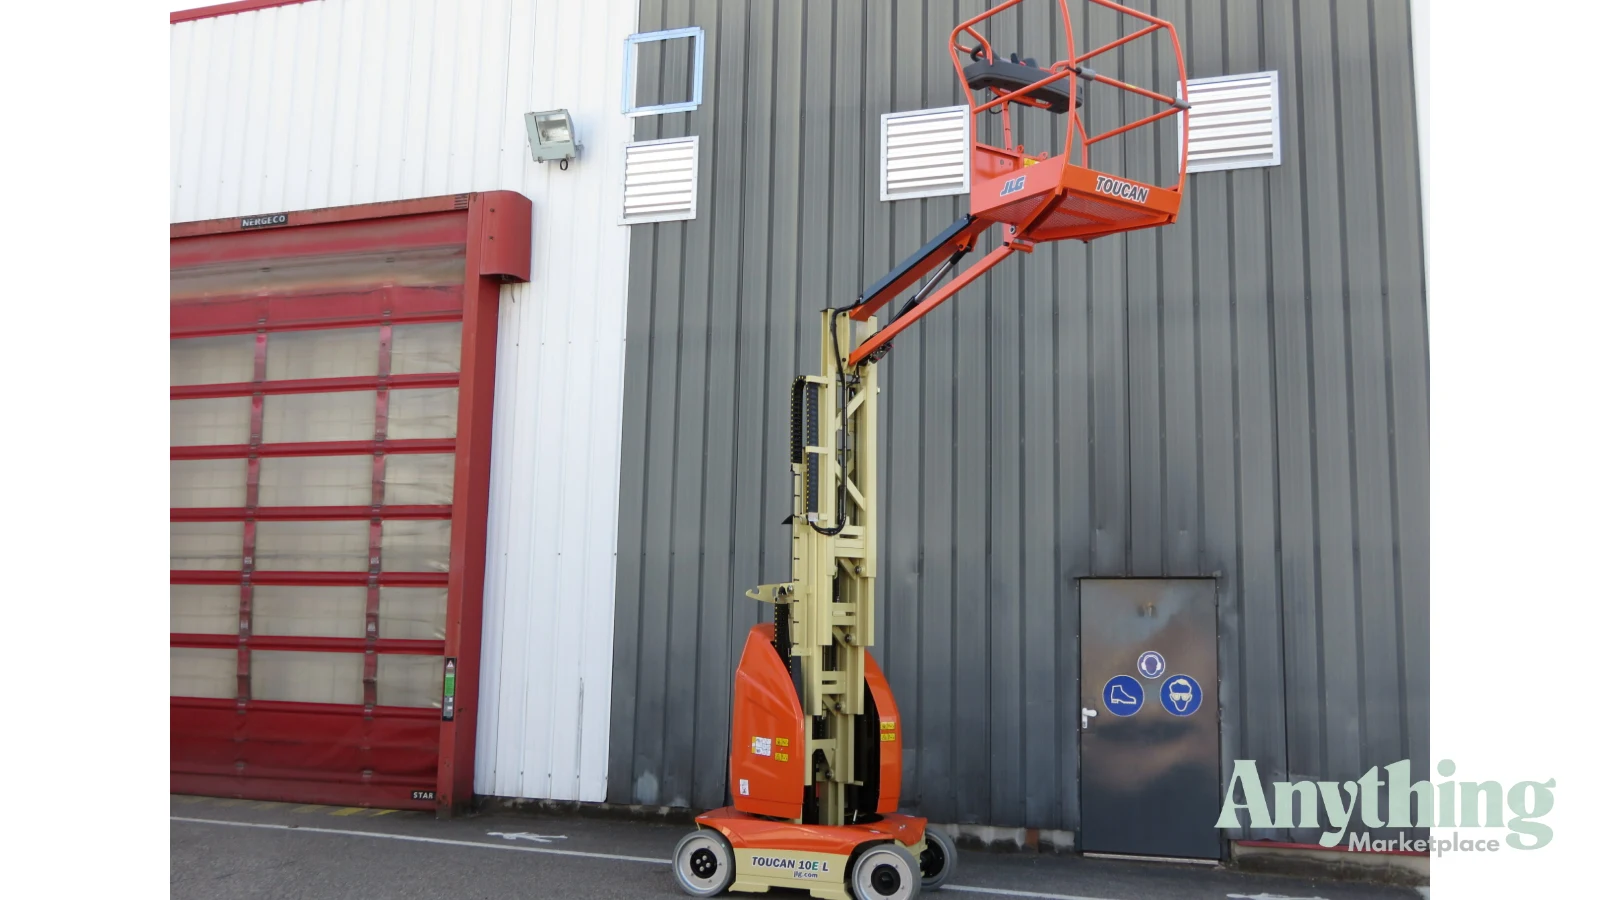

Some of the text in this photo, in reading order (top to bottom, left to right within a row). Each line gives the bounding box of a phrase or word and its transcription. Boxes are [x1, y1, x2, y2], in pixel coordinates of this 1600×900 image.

[1000, 176, 1026, 195] JLG
[1096, 176, 1149, 203] TOUCAN
[242, 215, 286, 227] NERGECO
[413, 791, 434, 799] STAR
[752, 856, 796, 869] TOUCAN
